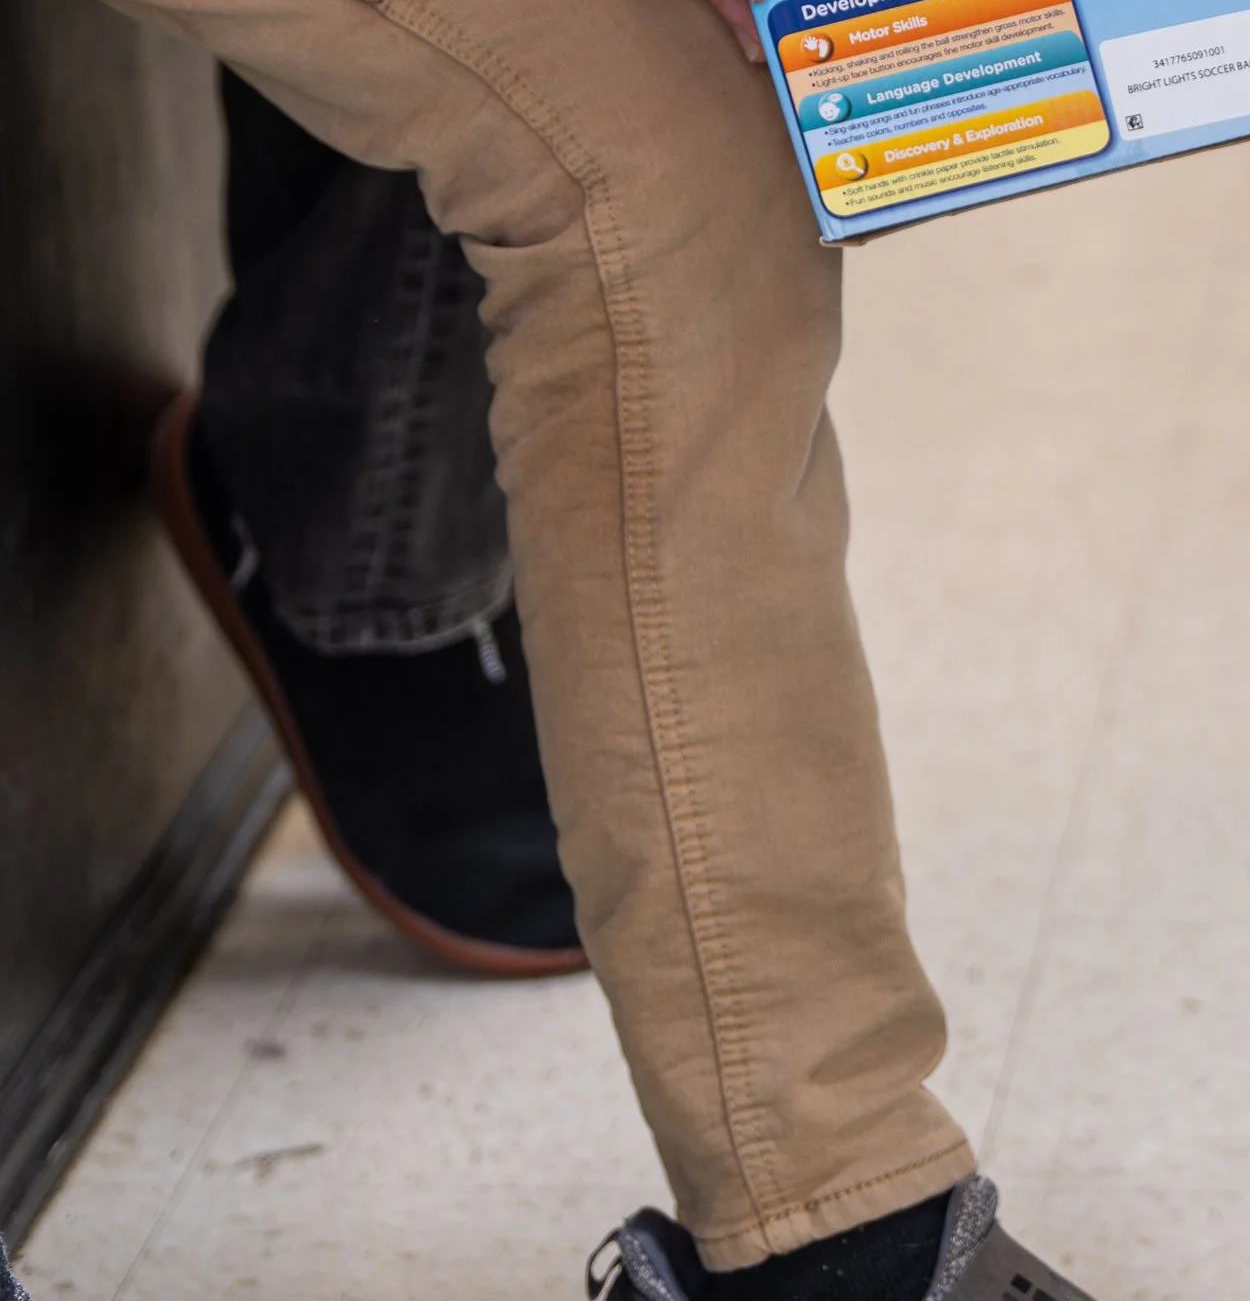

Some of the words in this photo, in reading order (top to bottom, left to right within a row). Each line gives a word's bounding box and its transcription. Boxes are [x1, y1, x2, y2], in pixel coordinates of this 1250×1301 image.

[847, 54, 878, 67] shaking
[879, 49, 895, 60] and
[896, 45, 920, 57] rolling
[920, 40, 935, 49] the
[935, 36, 950, 47] ball
[951, 26, 993, 43] strengthen
[995, 21, 1017, 33] gross
[1018, 14, 1042, 25] motor
[1044, 8, 1066, 19] skills.
[849, 26, 890, 44] Motor
[892, 16, 928, 34] Skills
[815, 73, 850, 87] Light-up
[851, 68, 869, 79] face
[869, 61, 896, 74] button
[897, 51, 942, 67] encourages
[943, 46, 959, 55] fine
[959, 40, 984, 52] motor
[985, 35, 1000, 45] skill
[1001, 23, 1055, 41] development.
[867, 78, 940, 105] Language
[943, 51, 1042, 85] Development
[1127, 78, 1162, 94] BRIGHT
[1163, 71, 1197, 87] LIGHTS
[1197, 62, 1236, 80] SOCCER
[1152, 45, 1226, 69] 3417765091001
[828, 119, 869, 134] Sing-along
[869, 113, 893, 125] songs
[893, 108, 908, 119] and
[908, 105, 920, 115] fun
[921, 100, 951, 113] phrases
[952, 91, 986, 105] introduce
[1045, 66, 1087, 82] vocabulary.
[833, 133, 865, 145] Teaches
[866, 127, 893, 138] colors,
[894, 117, 930, 131] numbers
[930, 112, 945, 122] and
[947, 103, 987, 118] opposites.
[884, 138, 951, 163] Discovery
[953, 132, 963, 146] &
[965, 115, 1043, 142] Exploration
[846, 183, 864, 194] Soft
[864, 179, 889, 189] hands
[892, 173, 908, 183] with
[909, 167, 935, 179] crinkle
[936, 162, 960, 175] paper
[960, 154, 990, 168] provide
[990, 147, 1015, 159] tactile
[849, 194, 866, 205] Fun
[867, 187, 897, 200] sounds
[898, 183, 913, 193] and
[914, 177, 938, 188] music
[939, 167, 981, 183] encourage
[982, 160, 1015, 173] listening
[1016, 154, 1038, 165] skills.
